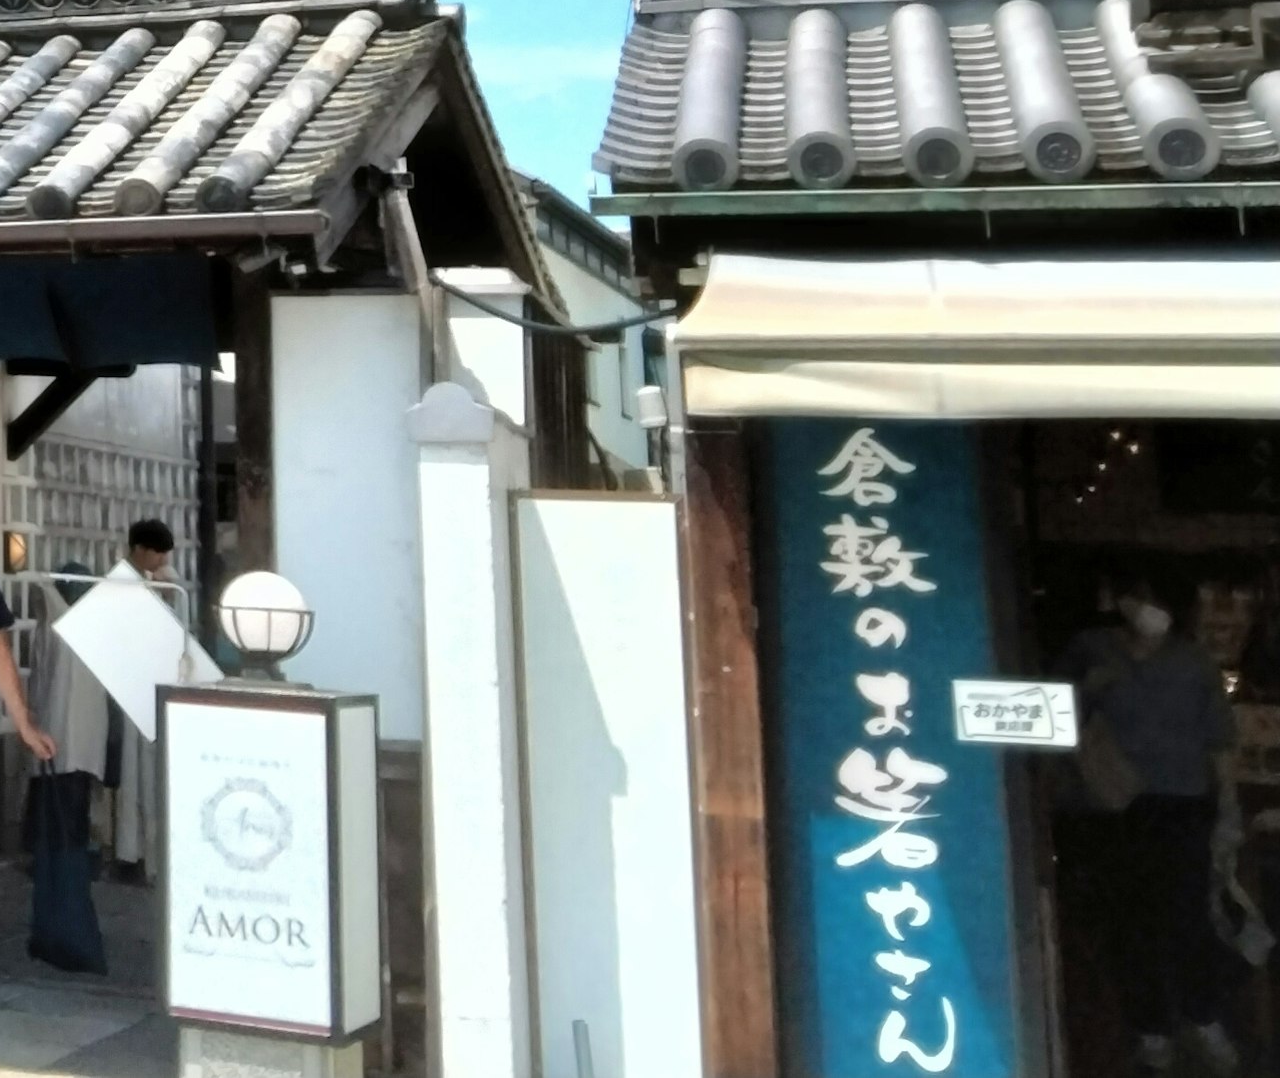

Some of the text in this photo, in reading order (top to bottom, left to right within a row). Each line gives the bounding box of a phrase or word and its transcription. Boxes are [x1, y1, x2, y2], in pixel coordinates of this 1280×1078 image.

[973, 703, 1043, 720] おかやま
[189, 904, 311, 949] AMOR
